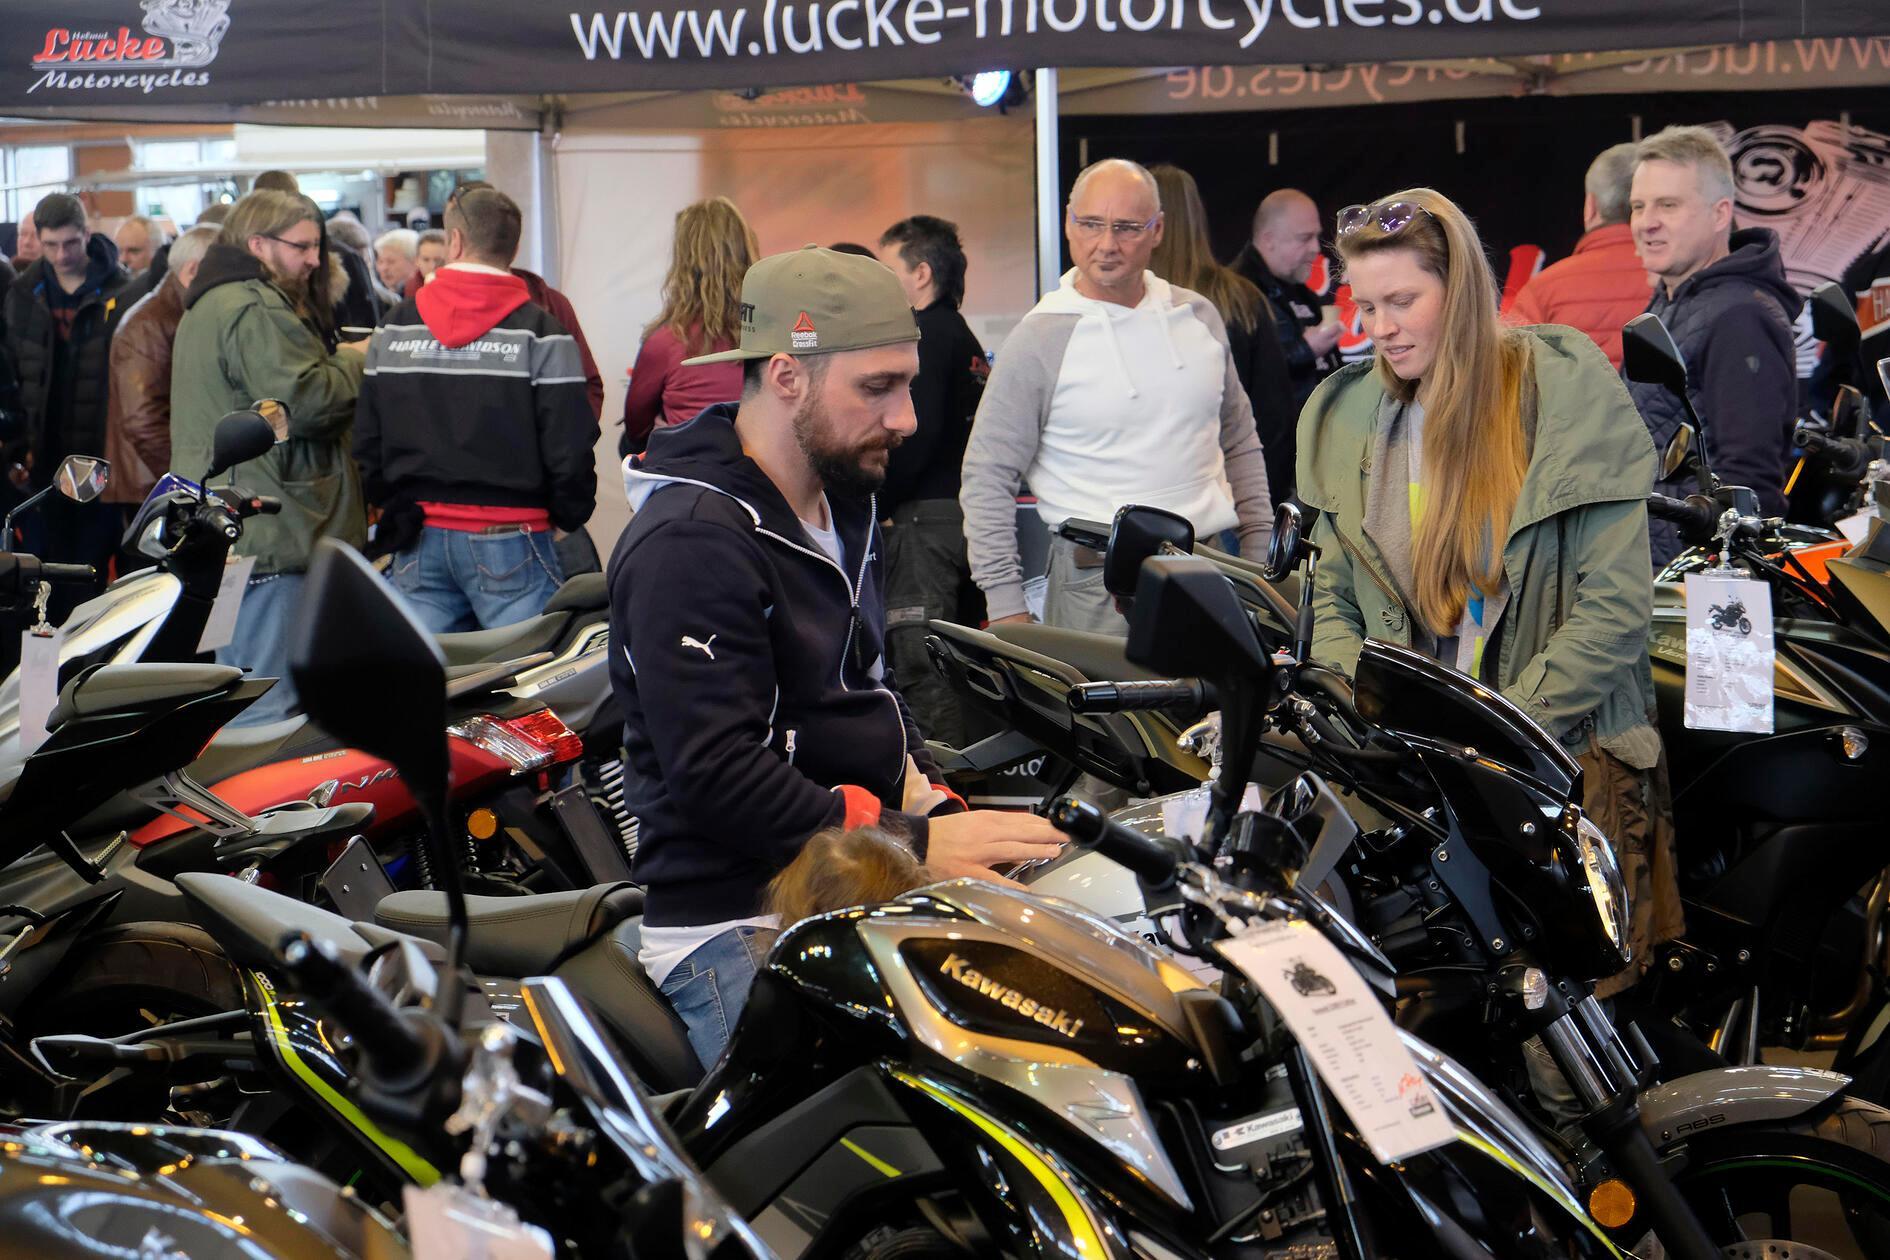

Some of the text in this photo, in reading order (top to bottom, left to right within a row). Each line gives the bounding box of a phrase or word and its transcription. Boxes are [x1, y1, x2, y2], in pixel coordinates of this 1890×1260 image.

[33, 26, 167, 62] Lucke
[26, 68, 210, 94] Motorcycles
[791, 331, 817, 340] Reebok
[792, 340, 818, 348] CrossFit
[939, 952, 1085, 1039] Kawasaki
[1246, 1111, 1294, 1133] Kawasaki
[1676, 1113, 1726, 1135] ABS
